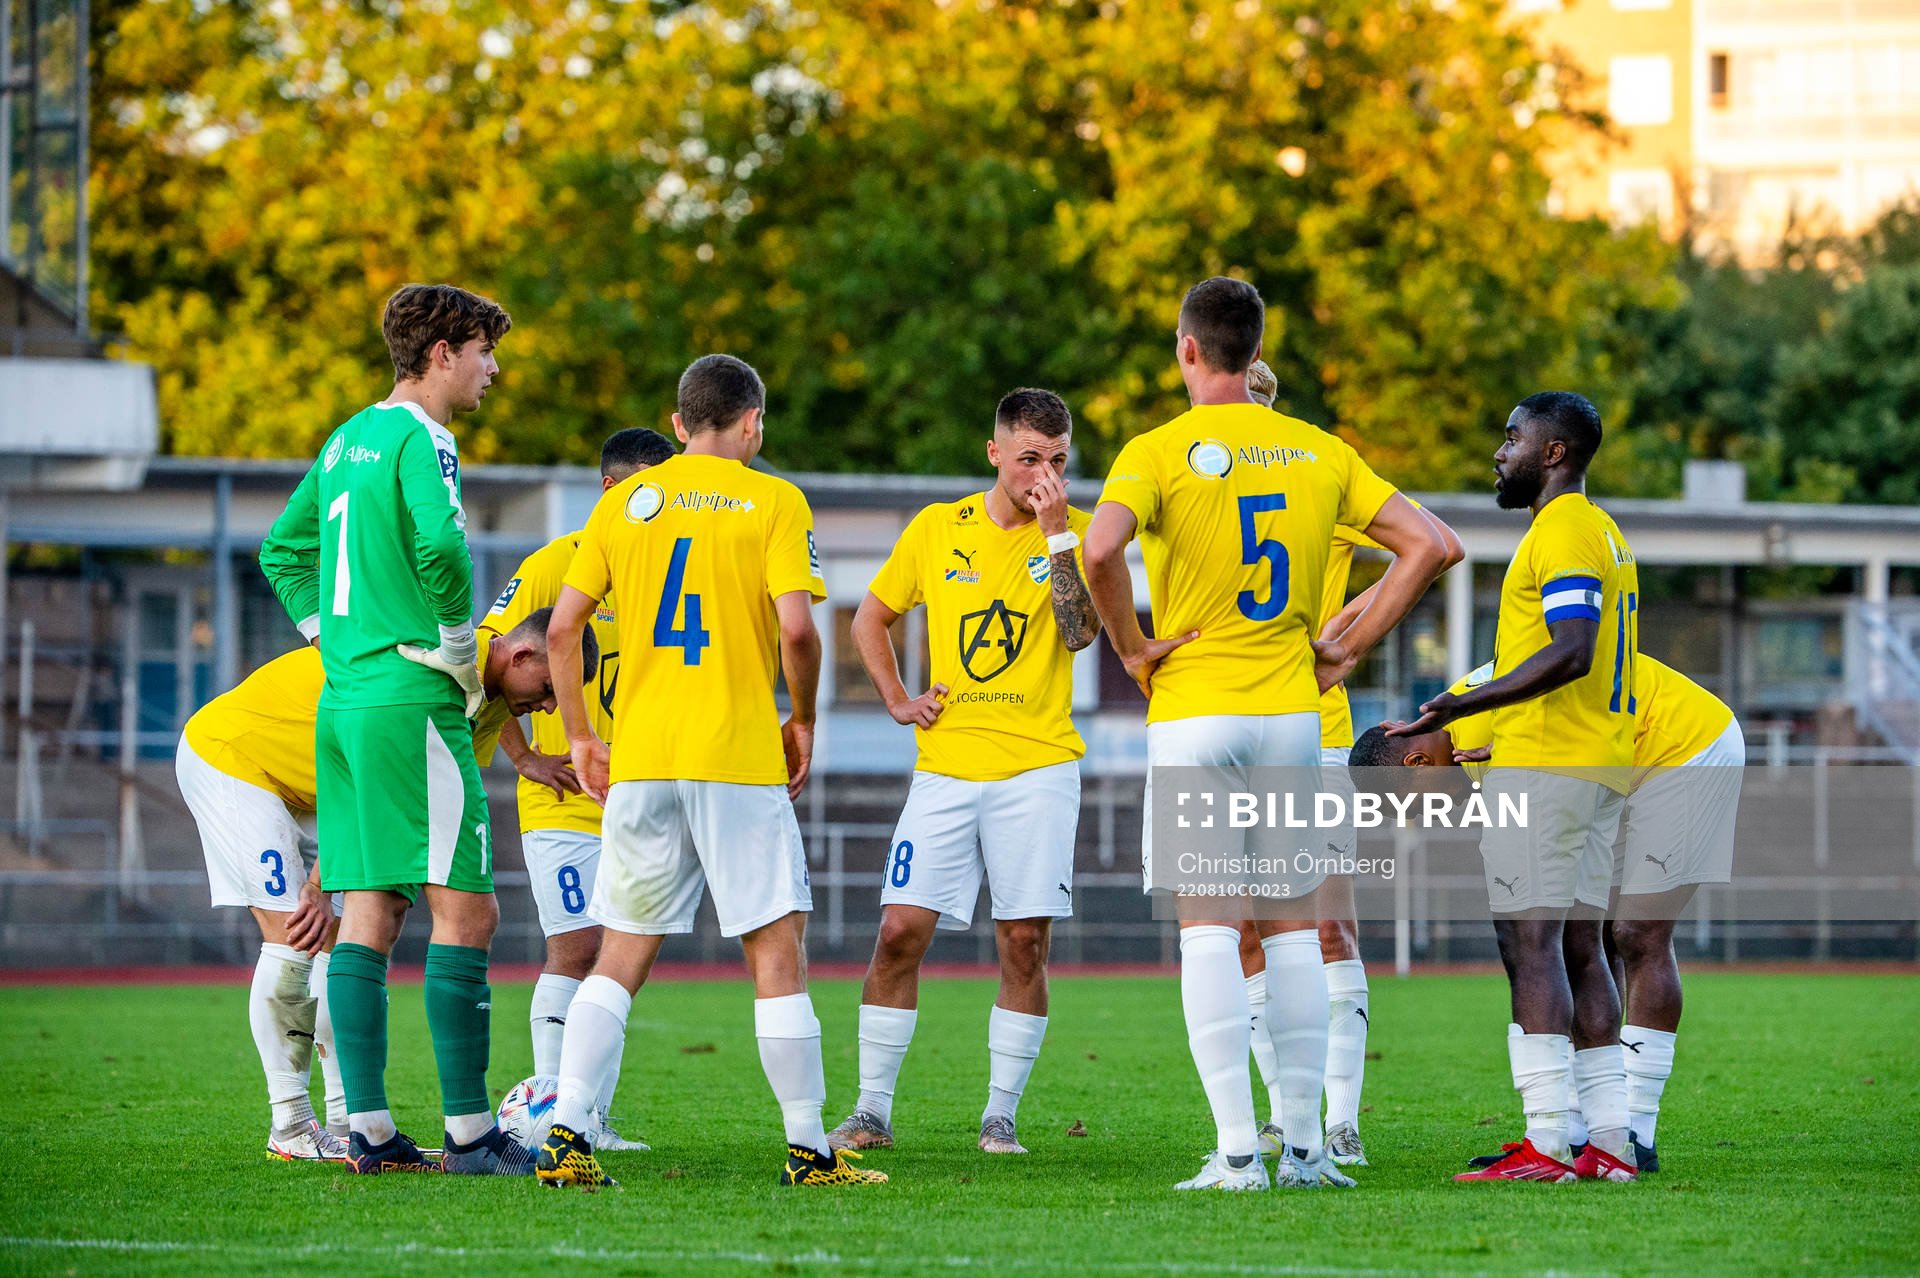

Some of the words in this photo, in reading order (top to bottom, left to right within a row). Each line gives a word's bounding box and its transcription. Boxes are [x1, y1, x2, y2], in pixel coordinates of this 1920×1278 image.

[1238, 445, 1305, 468] Allpipe
[670, 490, 741, 512] Allpipe
[327, 491, 351, 616] 1
[957, 569, 980, 577] INTER
[1237, 493, 1289, 621] 5
[597, 614, 614, 622] SPORT
[653, 537, 709, 665] 4
[260, 849, 287, 896] 3
[475, 823, 487, 876] 1
[557, 865, 586, 914] 8
